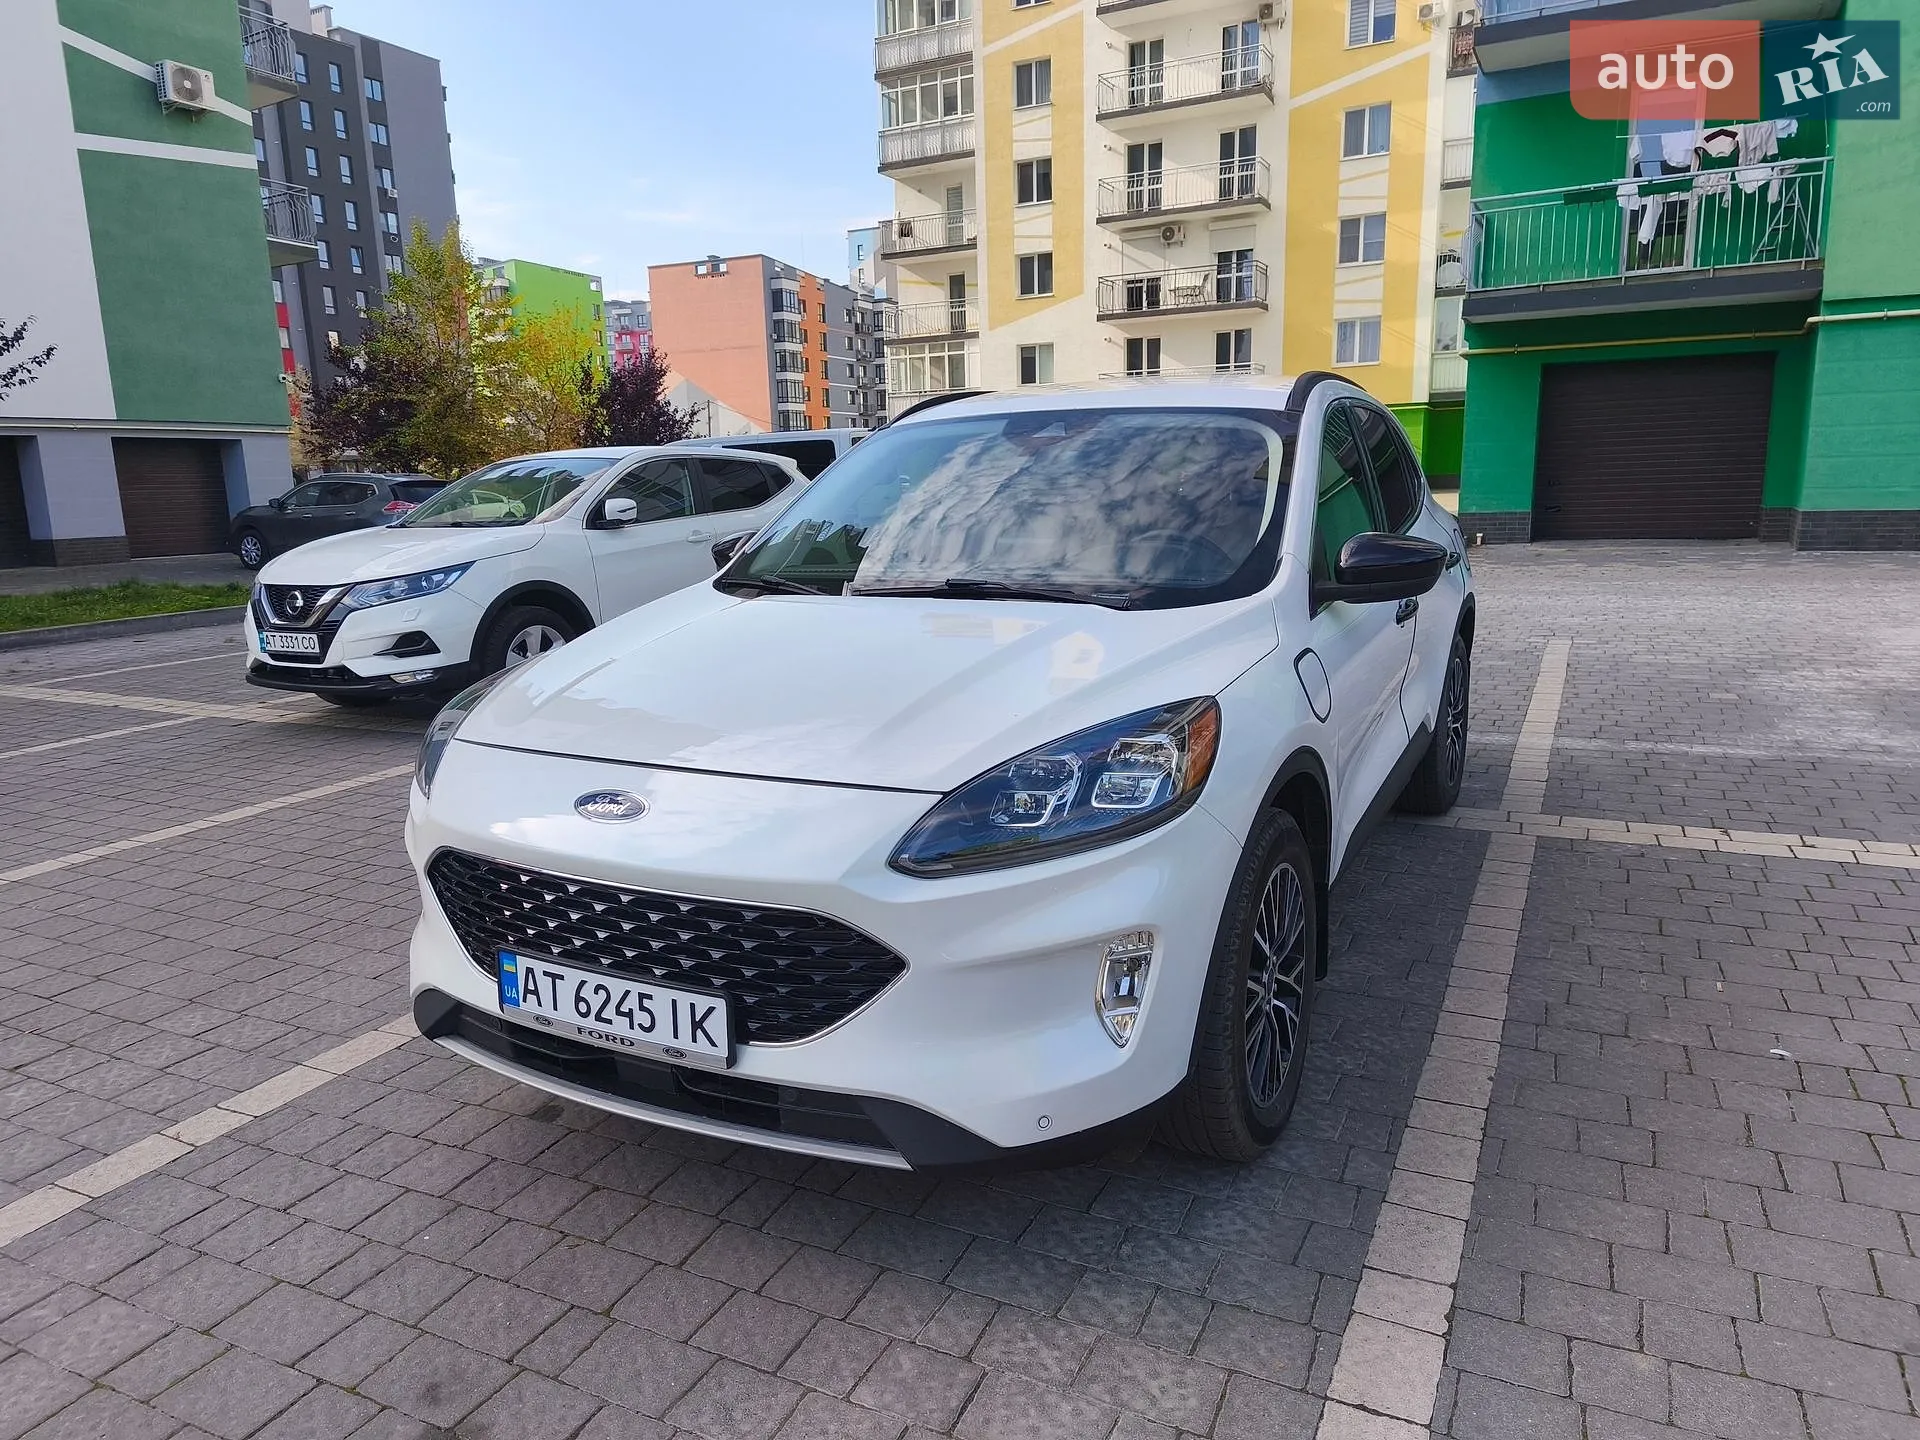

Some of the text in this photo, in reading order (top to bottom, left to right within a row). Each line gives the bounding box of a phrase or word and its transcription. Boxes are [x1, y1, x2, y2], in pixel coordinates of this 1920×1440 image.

[265, 634, 316, 650] AT 3331 CO
[580, 794, 632, 815] Ford
[504, 985, 518, 1000] UA
[522, 966, 719, 1048] AT 6245 IK
[576, 1026, 635, 1048] FORD
